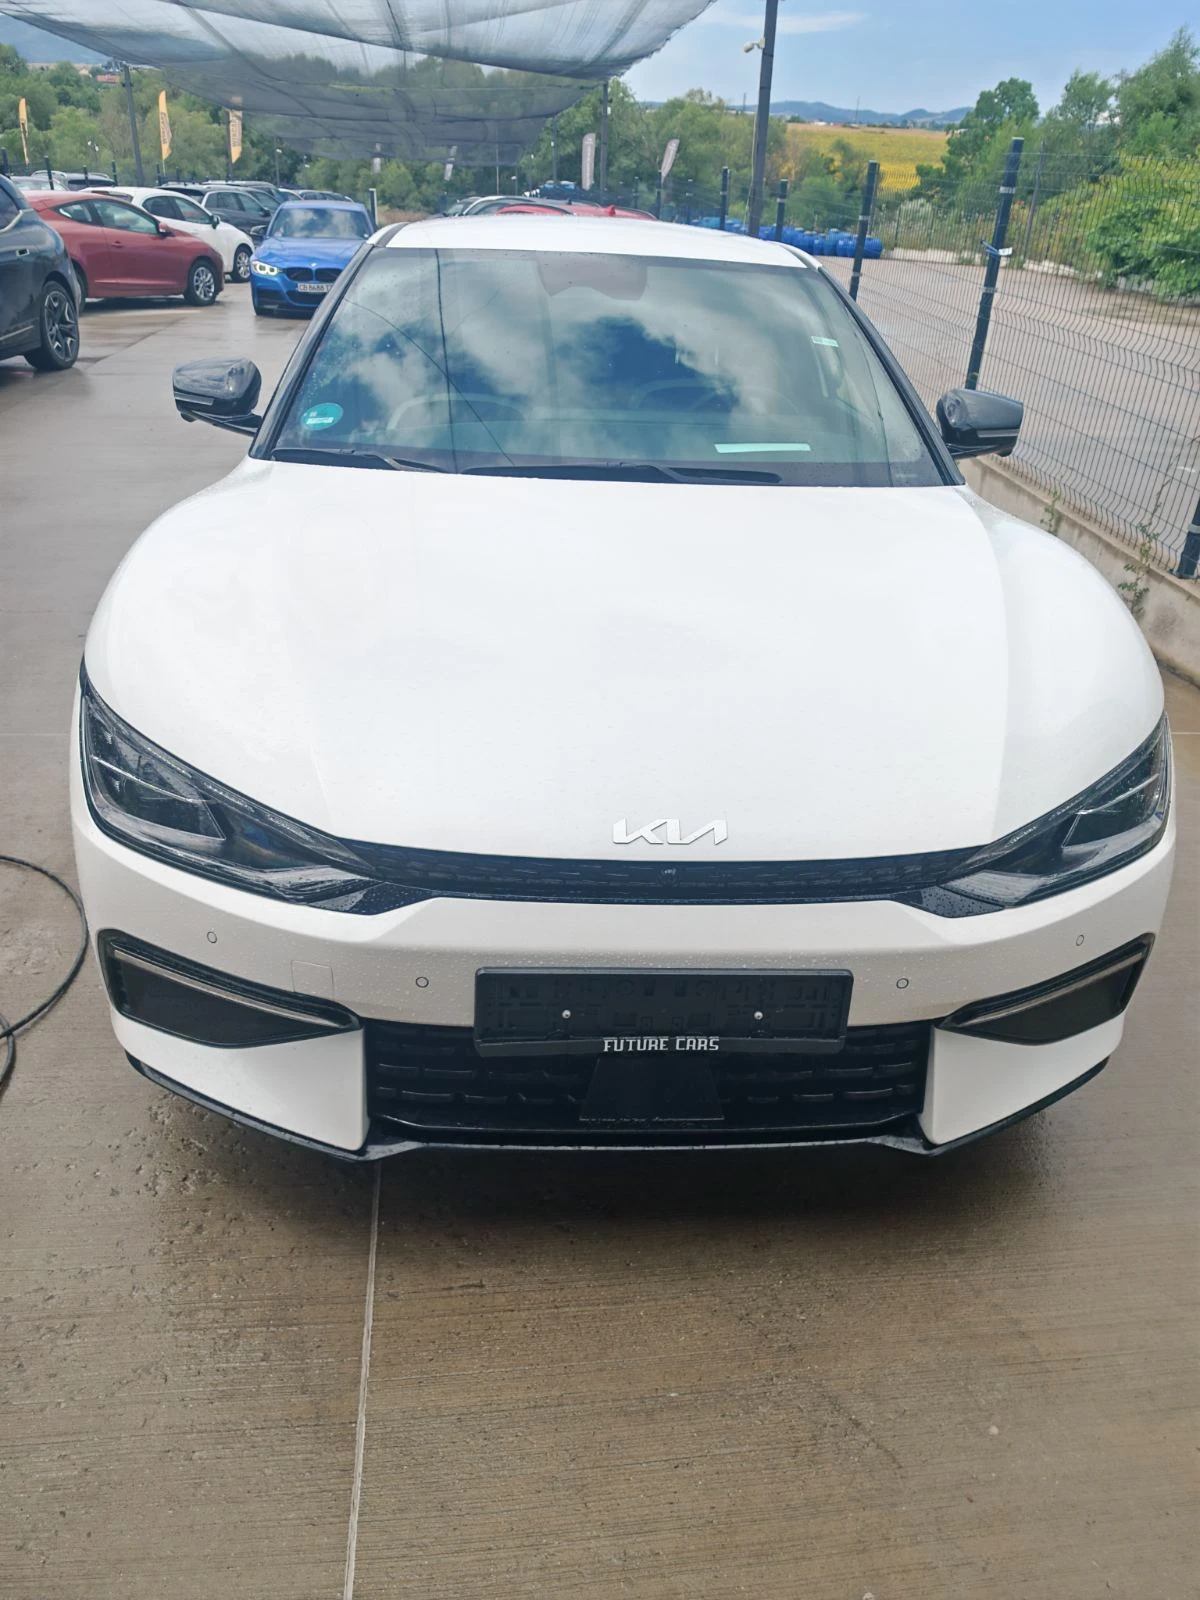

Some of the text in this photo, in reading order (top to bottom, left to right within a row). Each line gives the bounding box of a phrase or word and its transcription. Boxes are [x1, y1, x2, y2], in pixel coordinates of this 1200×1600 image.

[612, 818, 728, 846] KIA
[603, 1036, 720, 1052] FUTURE CARS
